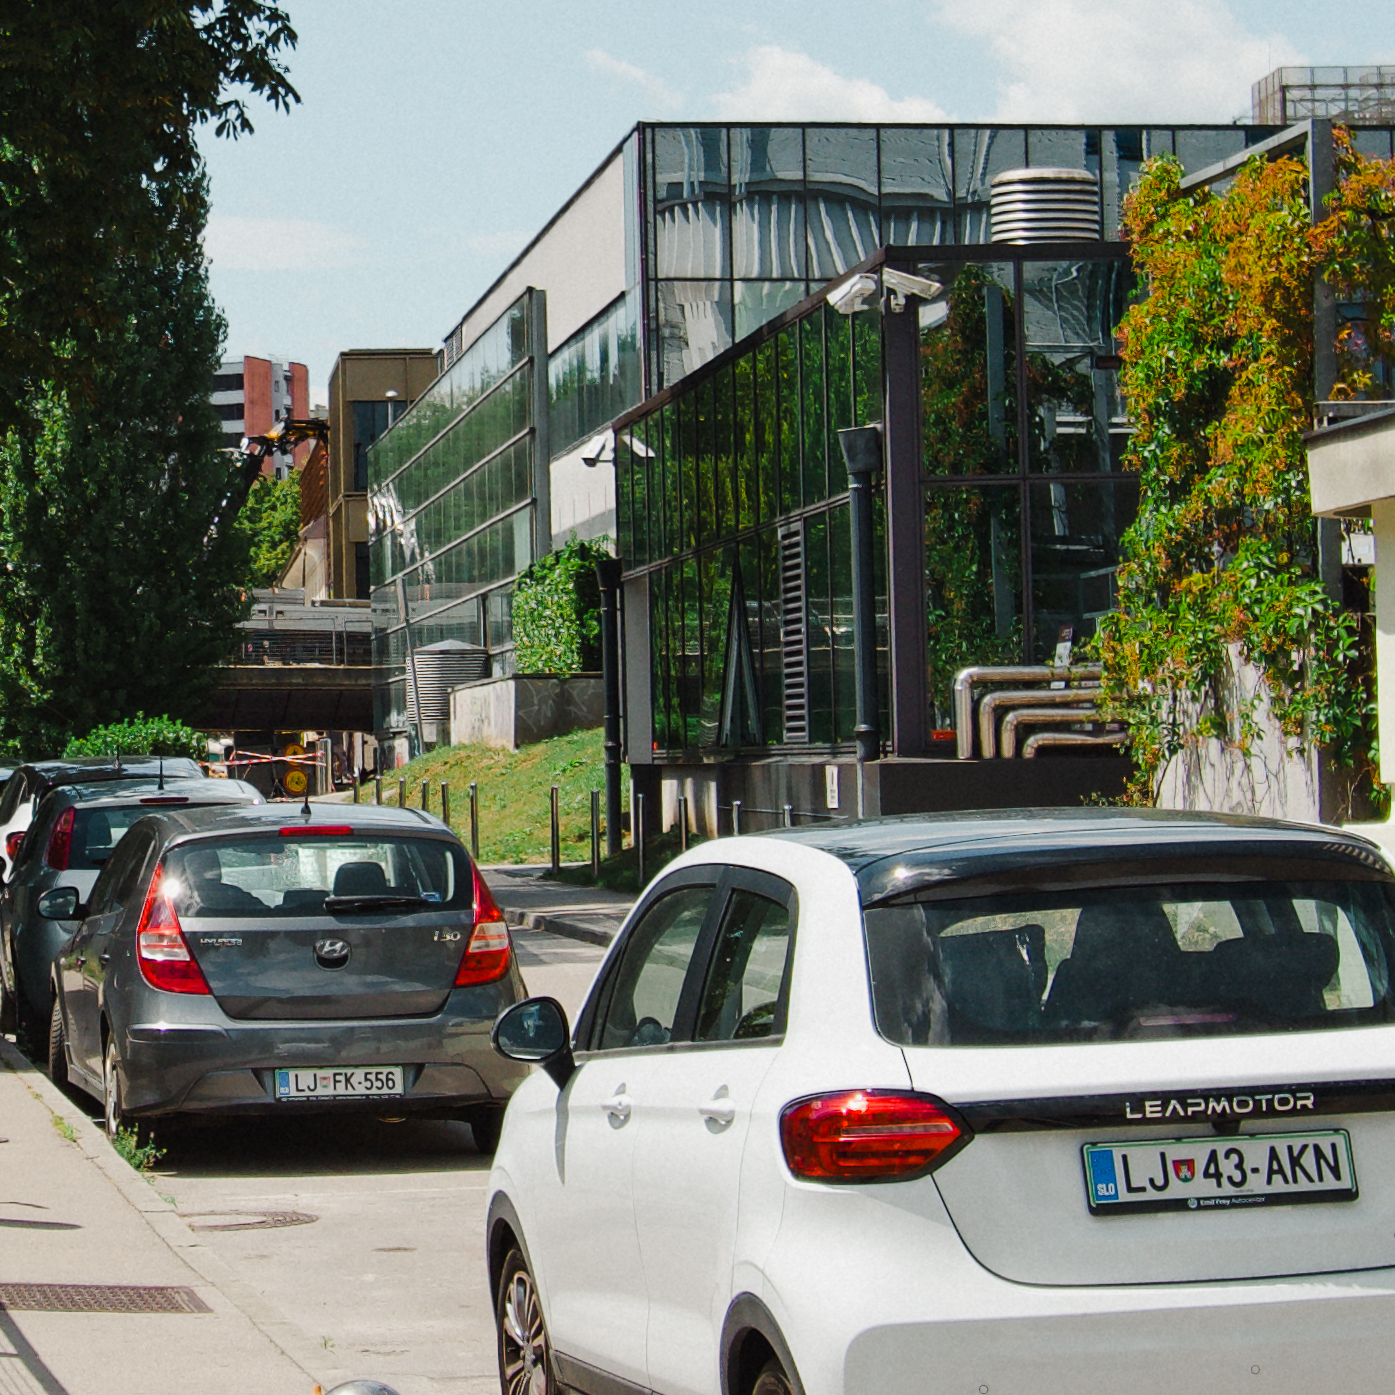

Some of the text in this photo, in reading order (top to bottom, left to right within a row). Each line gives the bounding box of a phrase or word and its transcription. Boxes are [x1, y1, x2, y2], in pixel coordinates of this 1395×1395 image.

[294, 1071, 396, 1092] LJ FK-556
[1125, 1092, 1315, 1119] LEAPMOTOR
[1121, 1141, 1342, 1194] LJ 43-AKN
[1097, 1182, 1115, 1196] SLO
